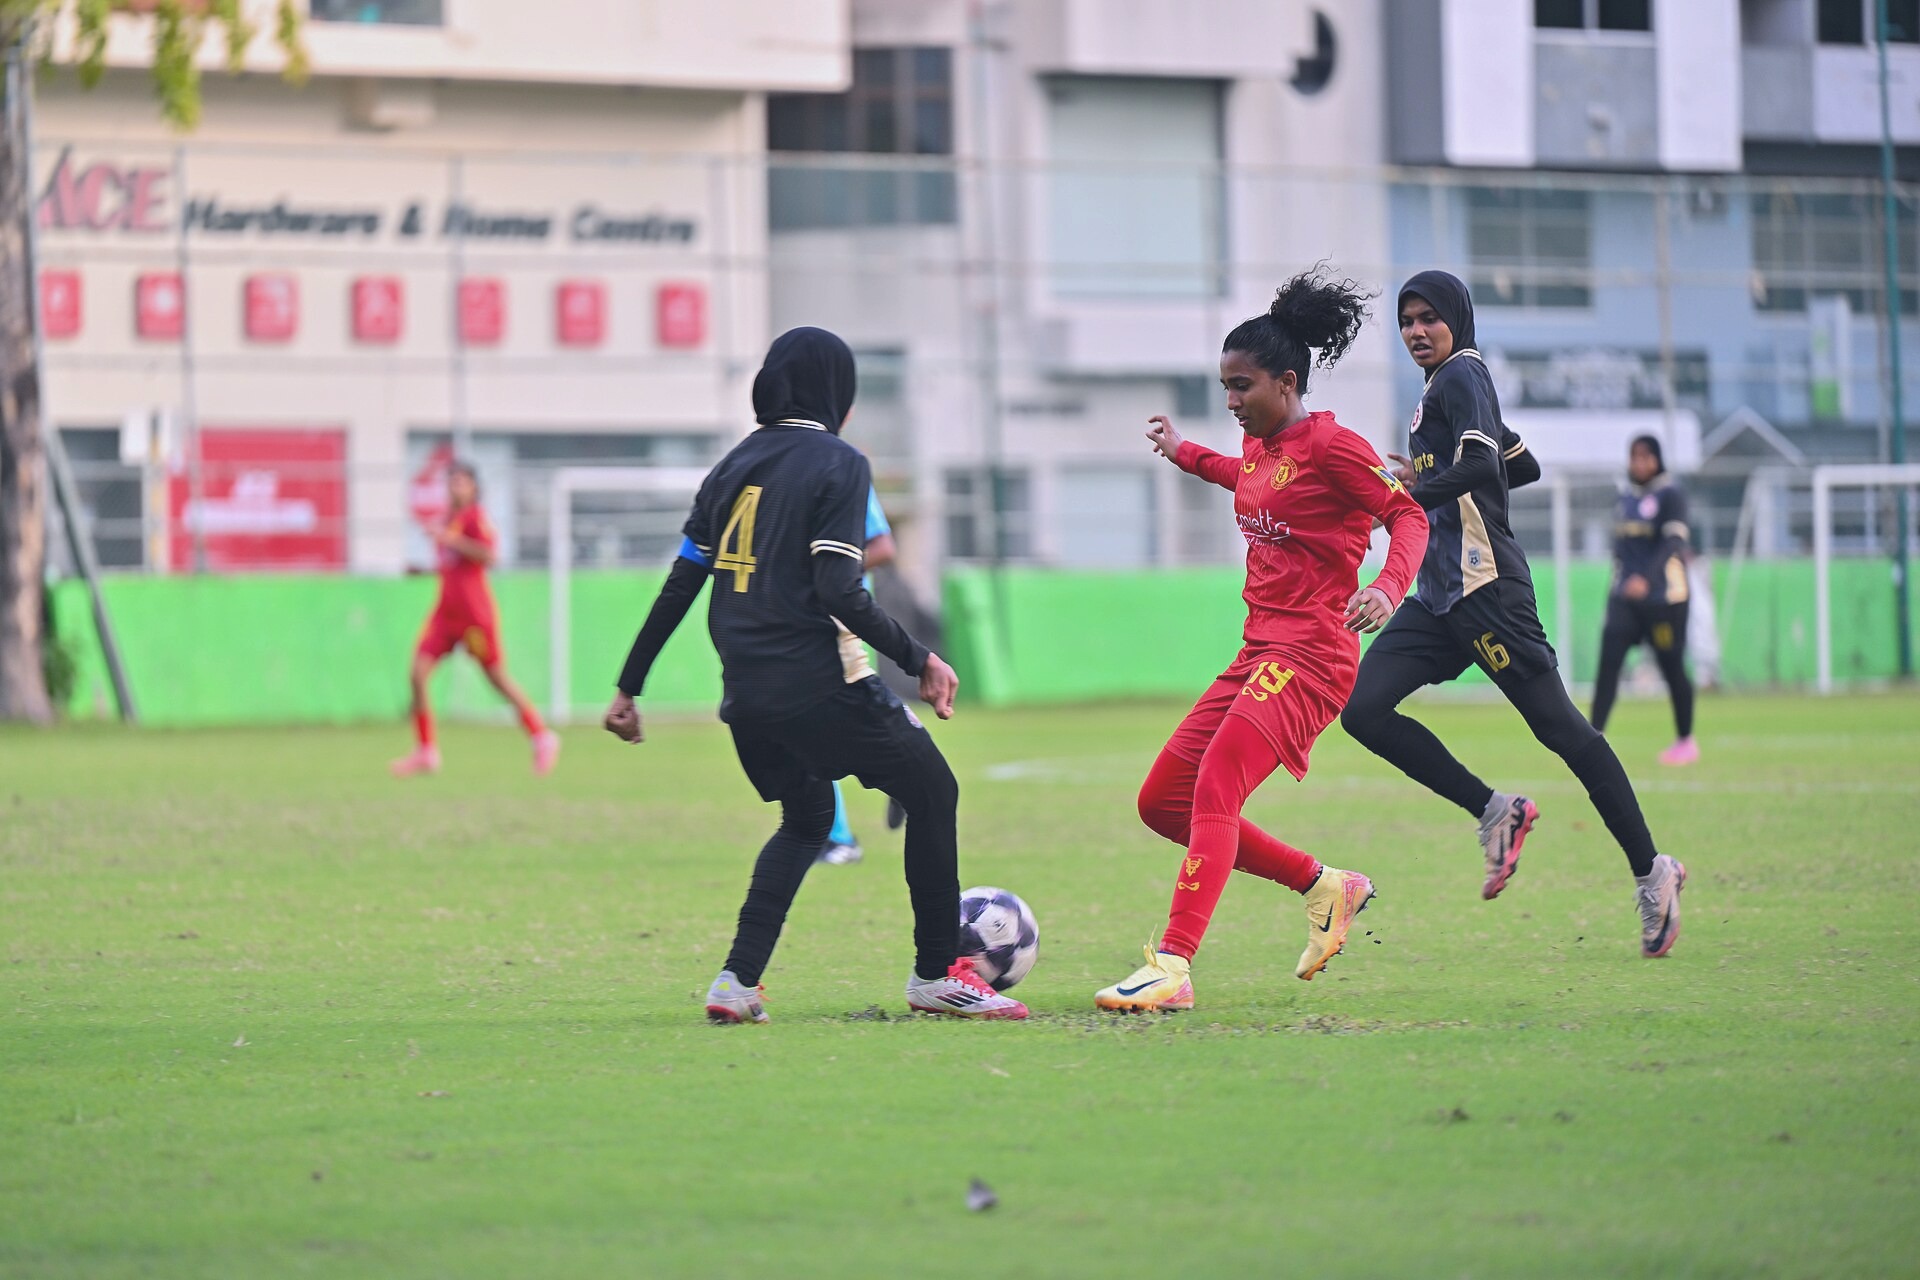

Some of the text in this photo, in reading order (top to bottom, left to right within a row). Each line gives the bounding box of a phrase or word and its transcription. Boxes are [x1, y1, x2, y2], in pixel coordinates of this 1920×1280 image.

[38, 143, 172, 232] ACE
[713, 485, 764, 593] 4
[1473, 631, 1510, 672] 16
